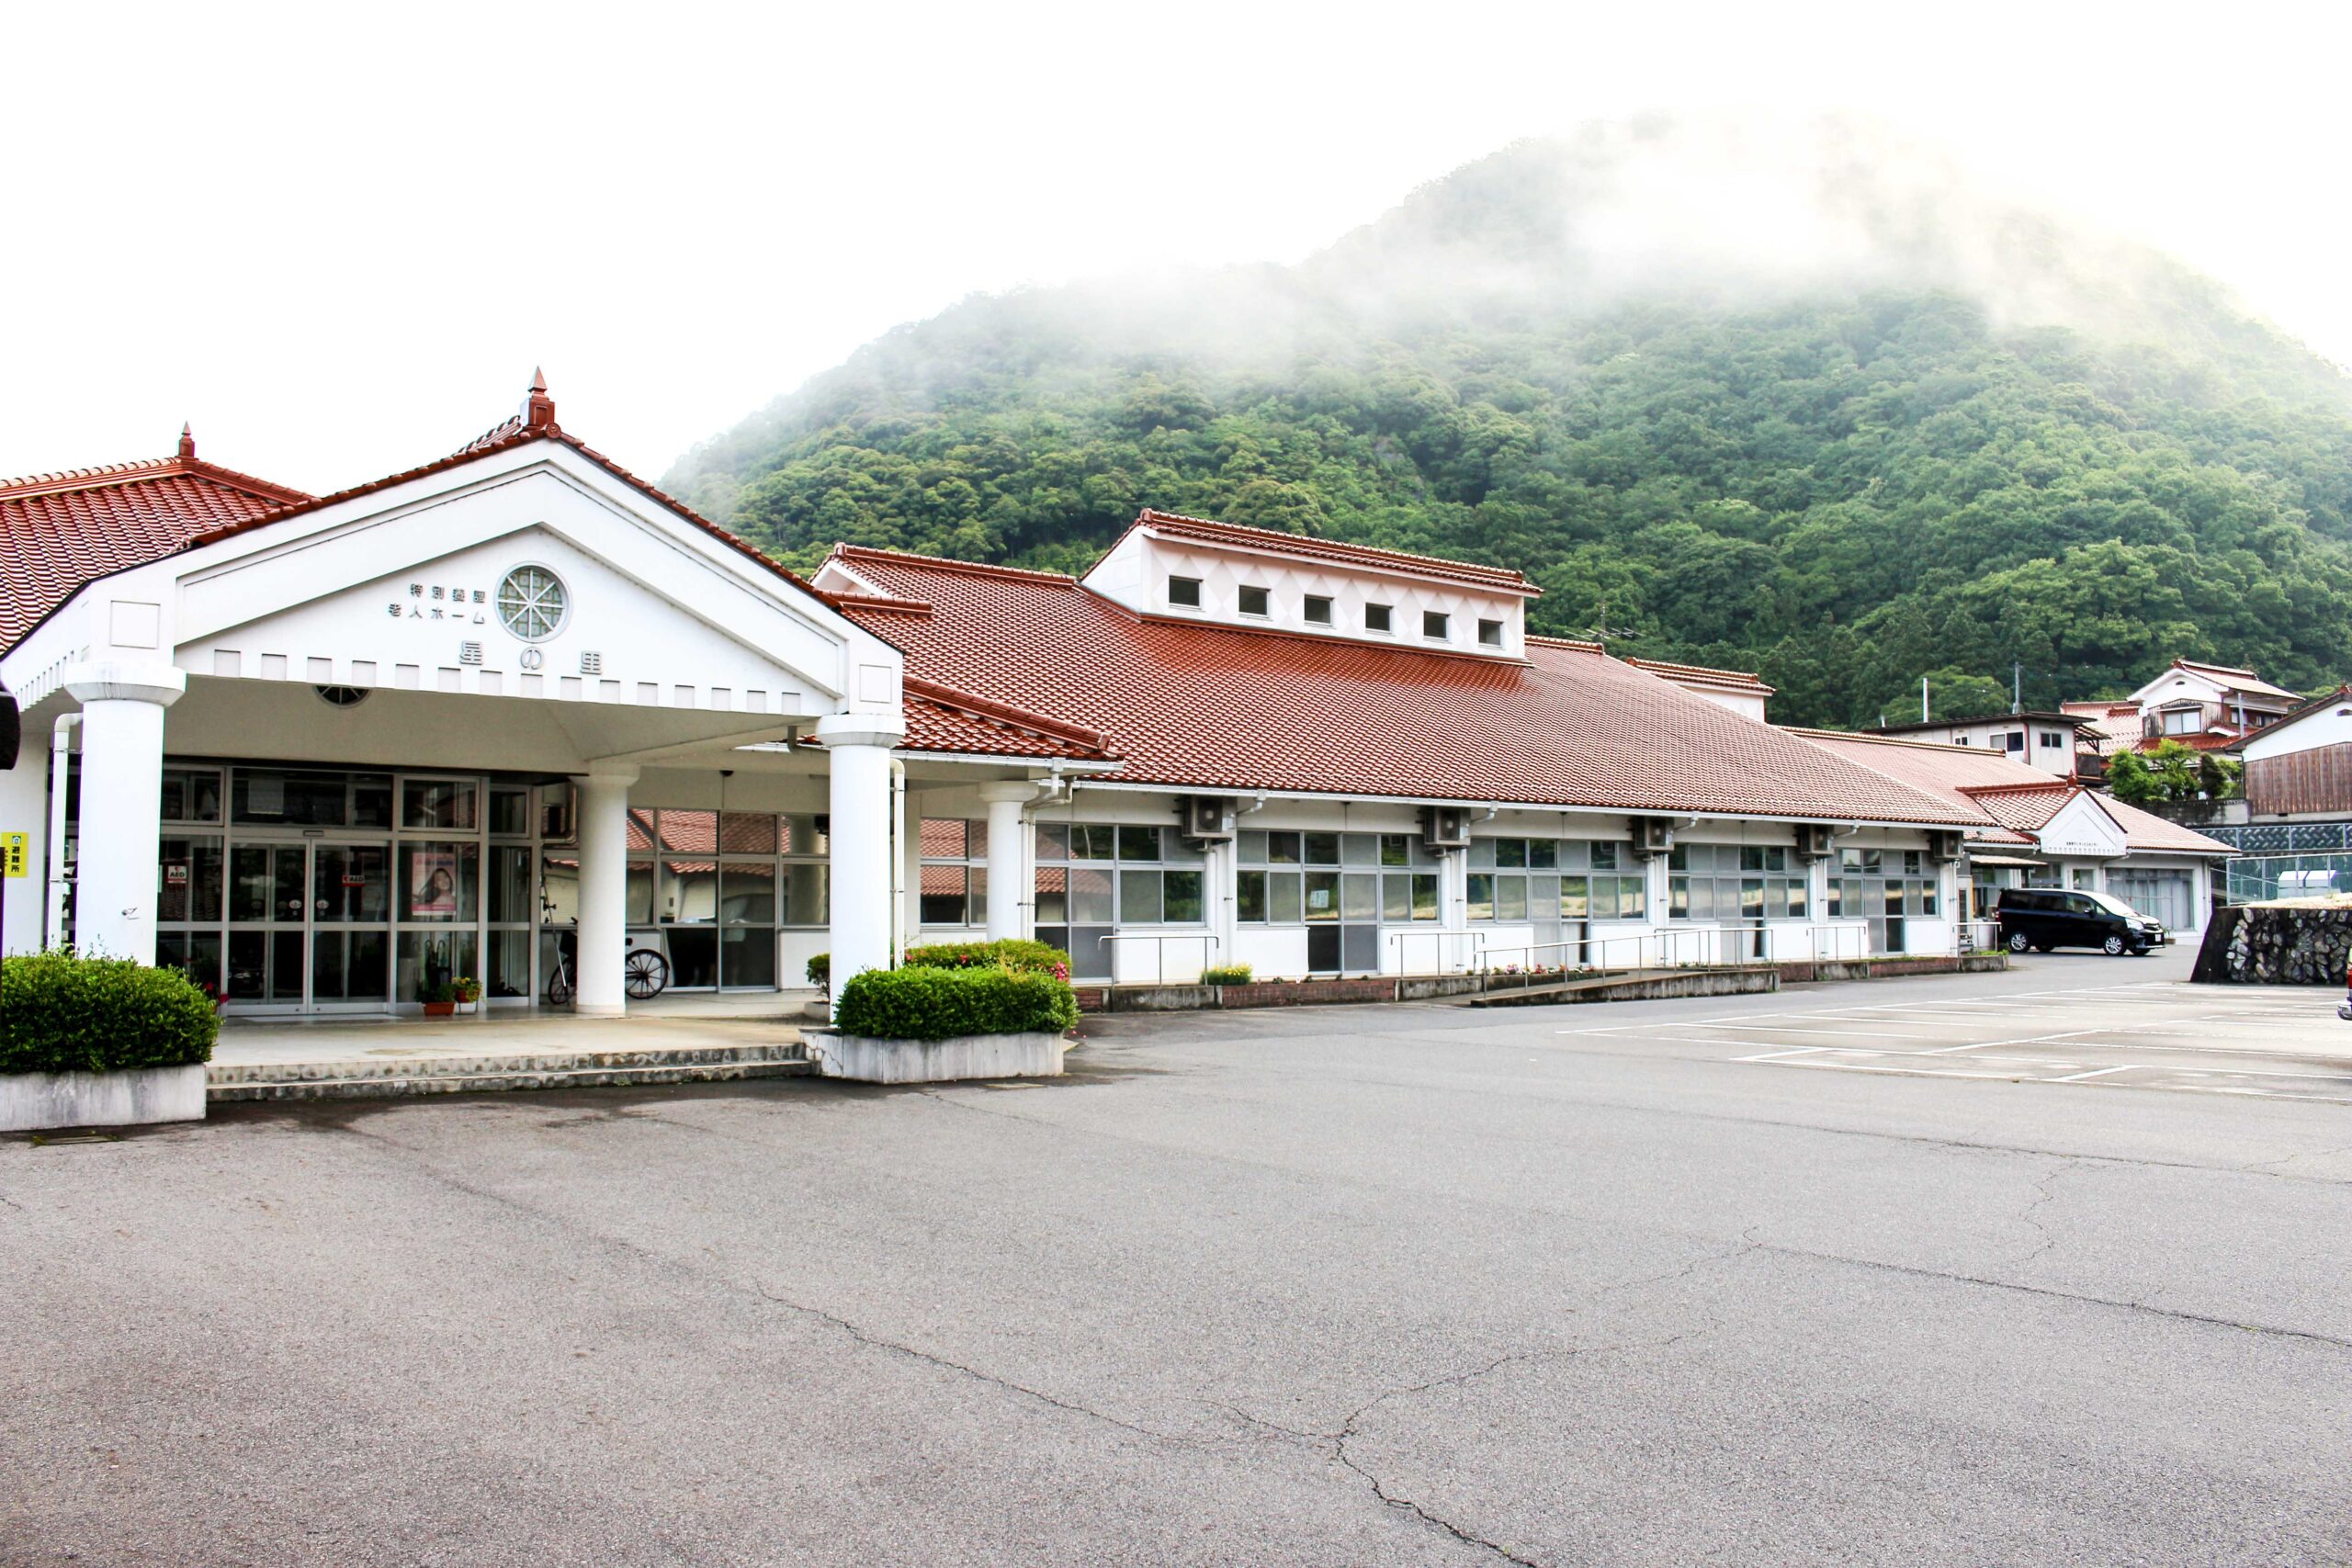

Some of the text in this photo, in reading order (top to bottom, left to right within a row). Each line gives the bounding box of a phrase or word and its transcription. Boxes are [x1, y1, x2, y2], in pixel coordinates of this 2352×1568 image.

[388, 603, 486, 625] 老人ホーム
[458, 639, 603, 676] 星の里
